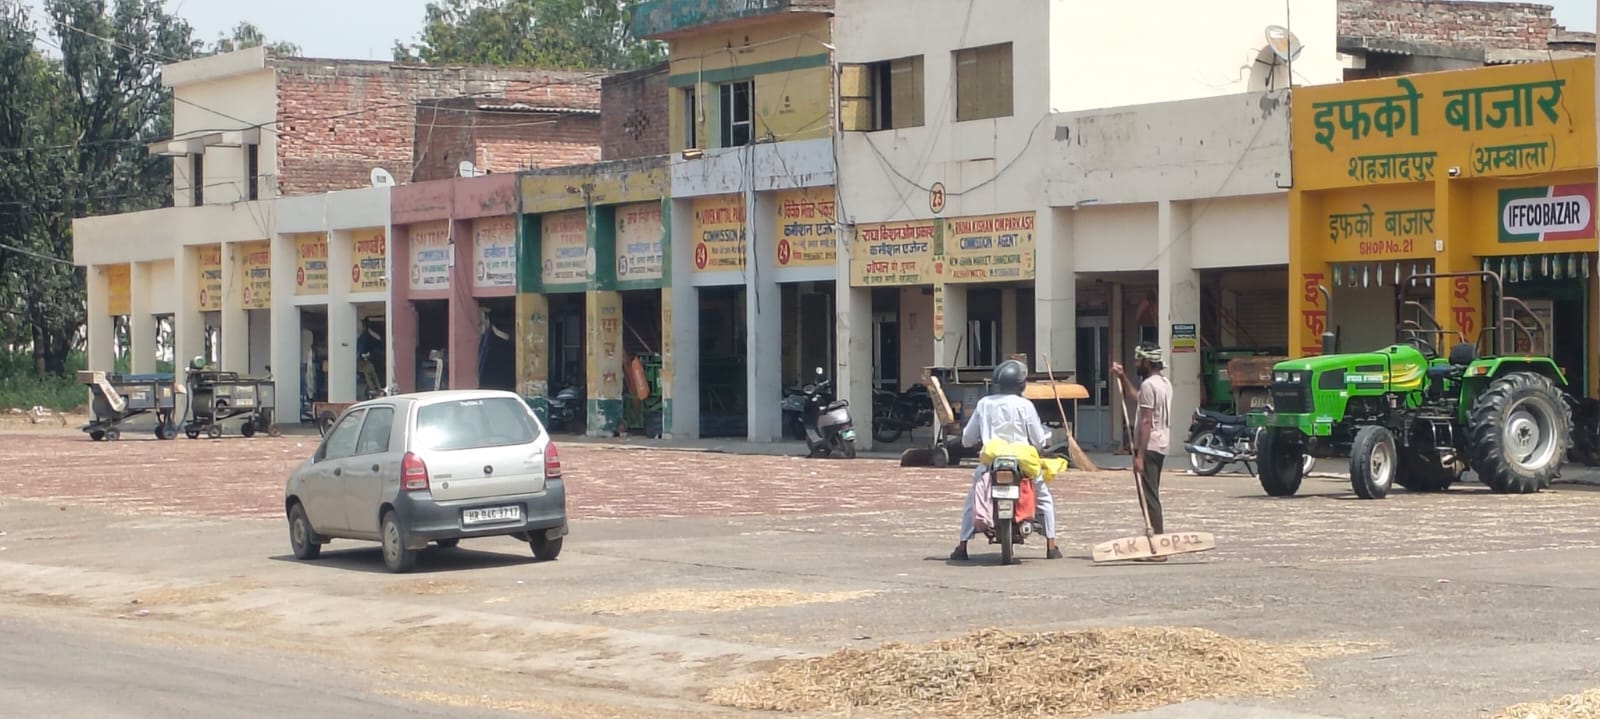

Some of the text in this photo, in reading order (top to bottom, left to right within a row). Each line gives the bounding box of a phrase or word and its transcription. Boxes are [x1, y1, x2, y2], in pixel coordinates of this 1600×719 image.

[1312, 79, 1565, 152] इफको बाजार
[1349, 152, 1437, 182] शहजादपुर
[932, 190, 943, 208] 23
[1329, 203, 1435, 243] इफको बाजार
[998, 234, 1018, 248] AGENT
[1359, 240, 1384, 255] SHOP
[1403, 239, 1413, 252] 21
